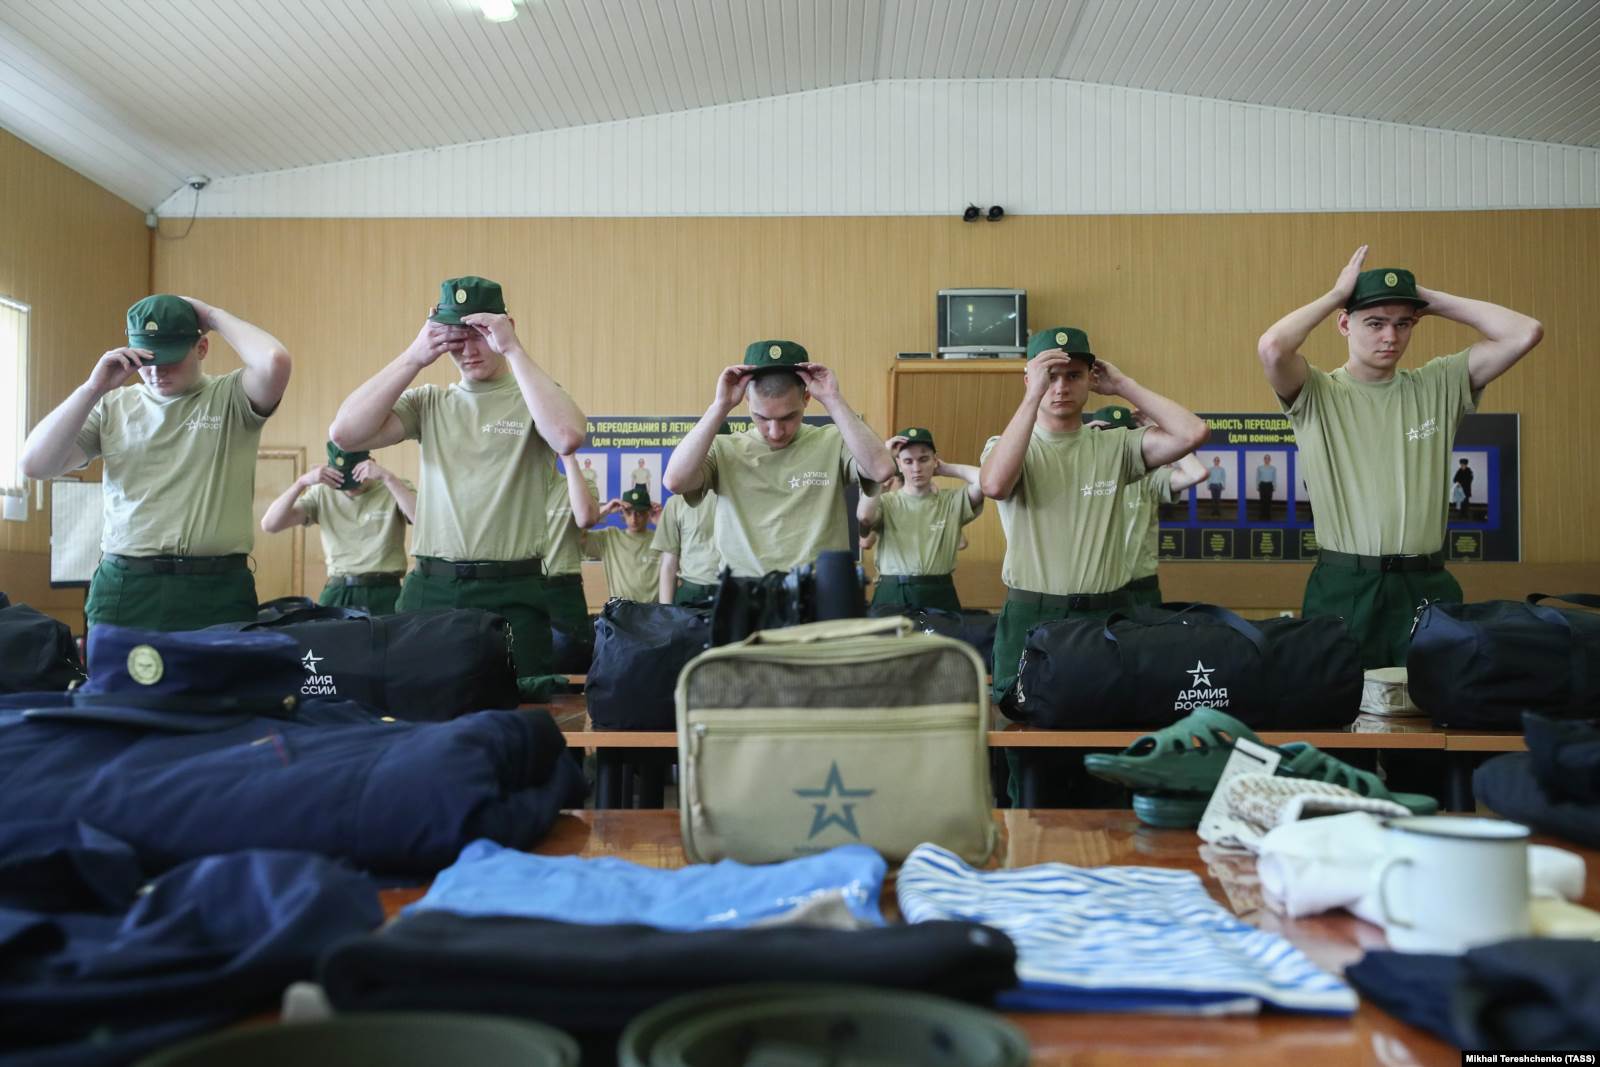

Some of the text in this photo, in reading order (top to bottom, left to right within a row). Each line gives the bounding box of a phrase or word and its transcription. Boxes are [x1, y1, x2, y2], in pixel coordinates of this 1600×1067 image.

[597, 422, 659, 433] ПЕРЕОДЕВАНИЯ
[661, 422, 668, 432] В
[669, 422, 697, 432] ЛЕТН
[1206, 419, 1293, 430] ЛЬНОСТЬ ПЕРЕОДЕВА
[592, 436, 611, 447] (для
[613, 438, 660, 448] сухопутных
[1228, 432, 1297, 443] (для военно-мо
[303, 675, 334, 685] МИЯ
[300, 685, 337, 695] ССИИ
[1177, 687, 1228, 700] АРМИЯ
[1174, 699, 1230, 711] РОССИИ
